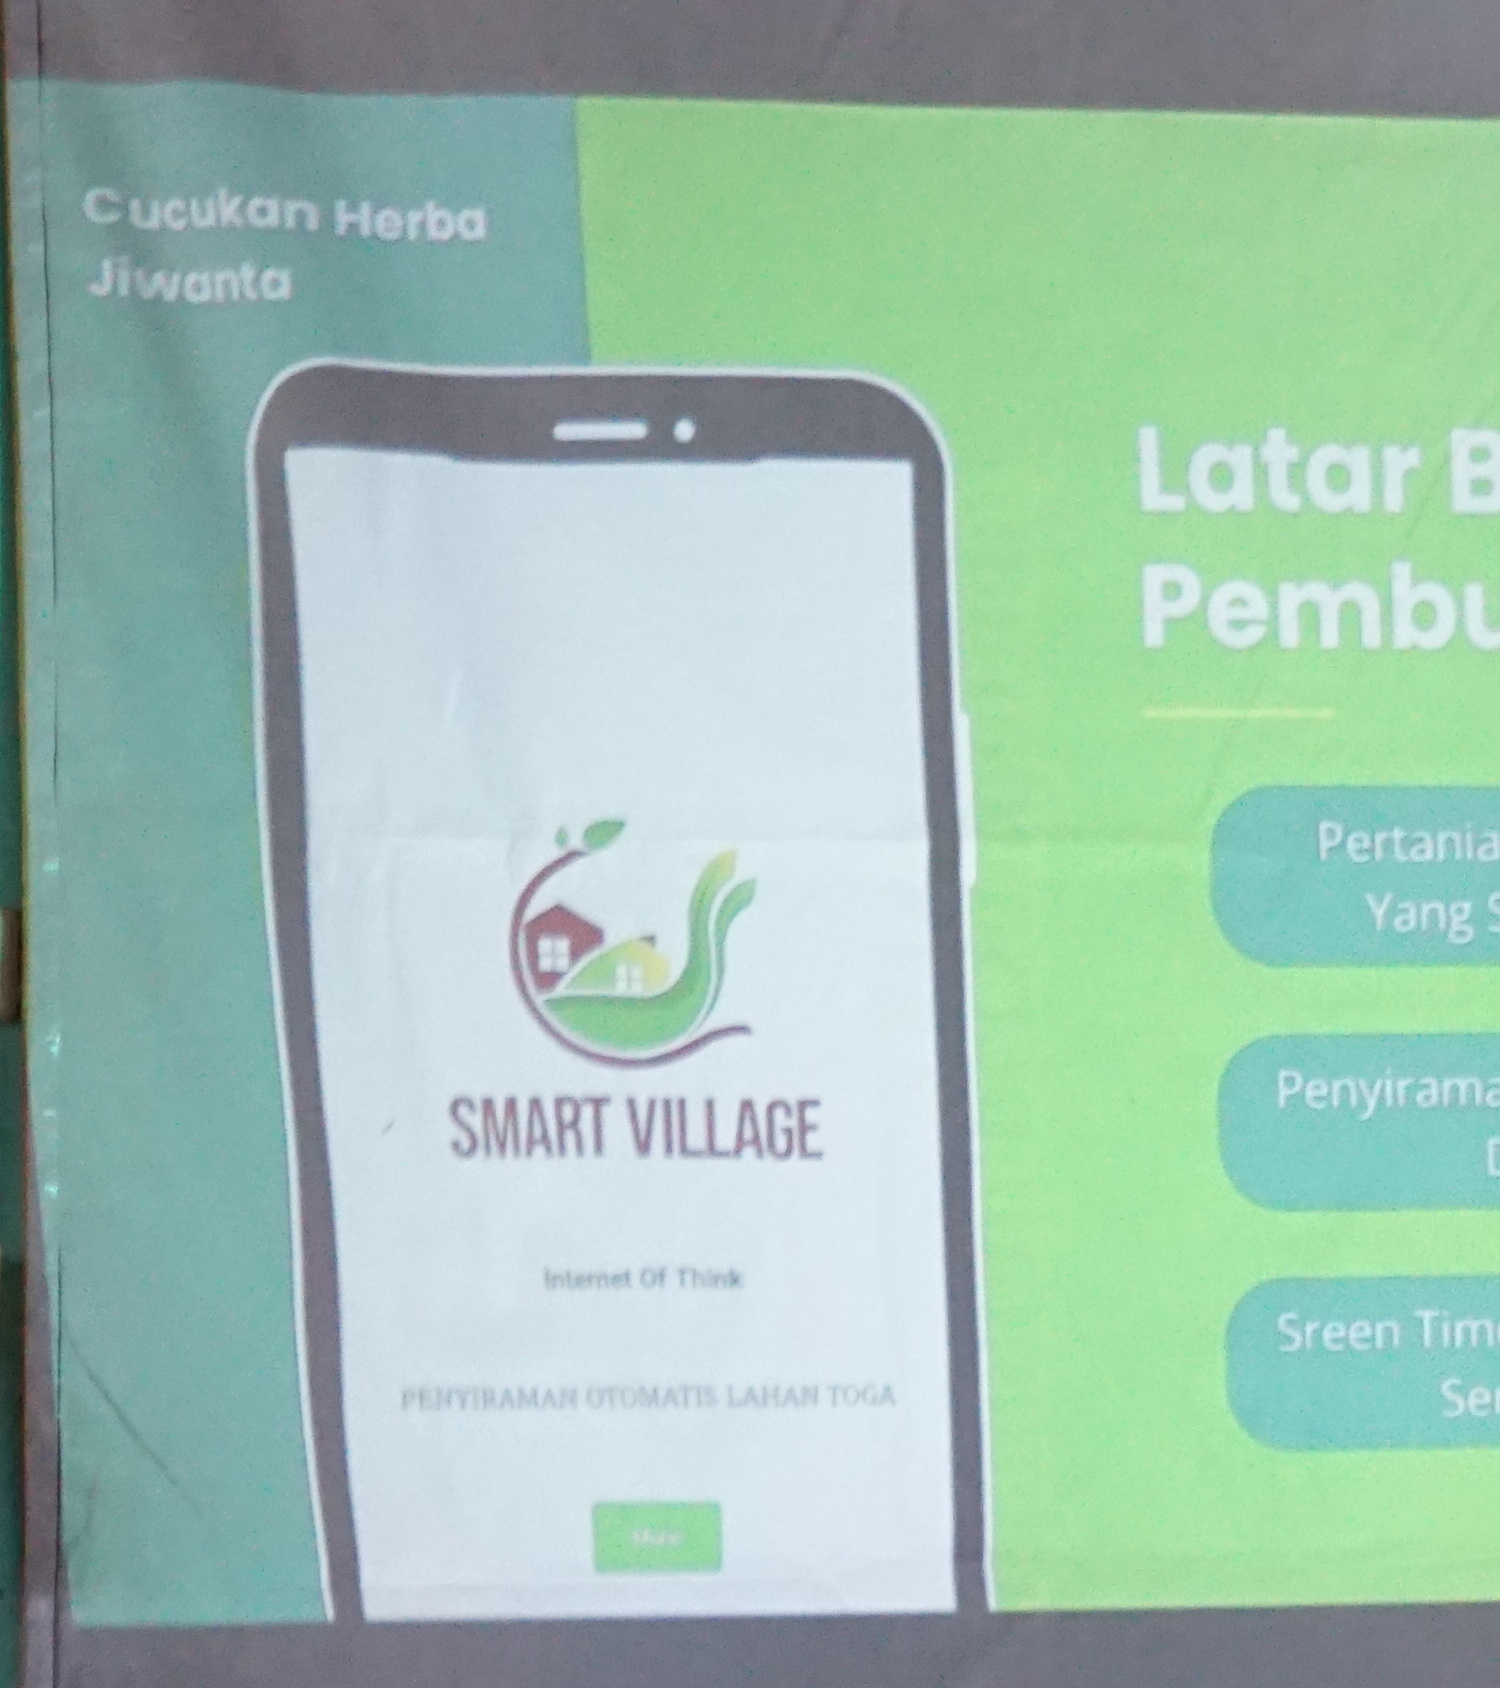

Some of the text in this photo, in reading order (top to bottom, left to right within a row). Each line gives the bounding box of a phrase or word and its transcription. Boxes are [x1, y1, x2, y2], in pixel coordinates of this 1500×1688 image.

[83, 186, 488, 242] Cucukan Herba
[87, 257, 293, 304] Jiwanta
[1137, 425, 1422, 515] Latar
[1365, 890, 1475, 944] Yang
[449, 1095, 825, 1163] SMART VILLAGE
[543, 1266, 745, 1291] Internet Of Think
[1276, 1309, 1401, 1353] Sreen
[402, 1383, 898, 1412] PENYIRAMAN OTOMATIS LAHAN TOGA
